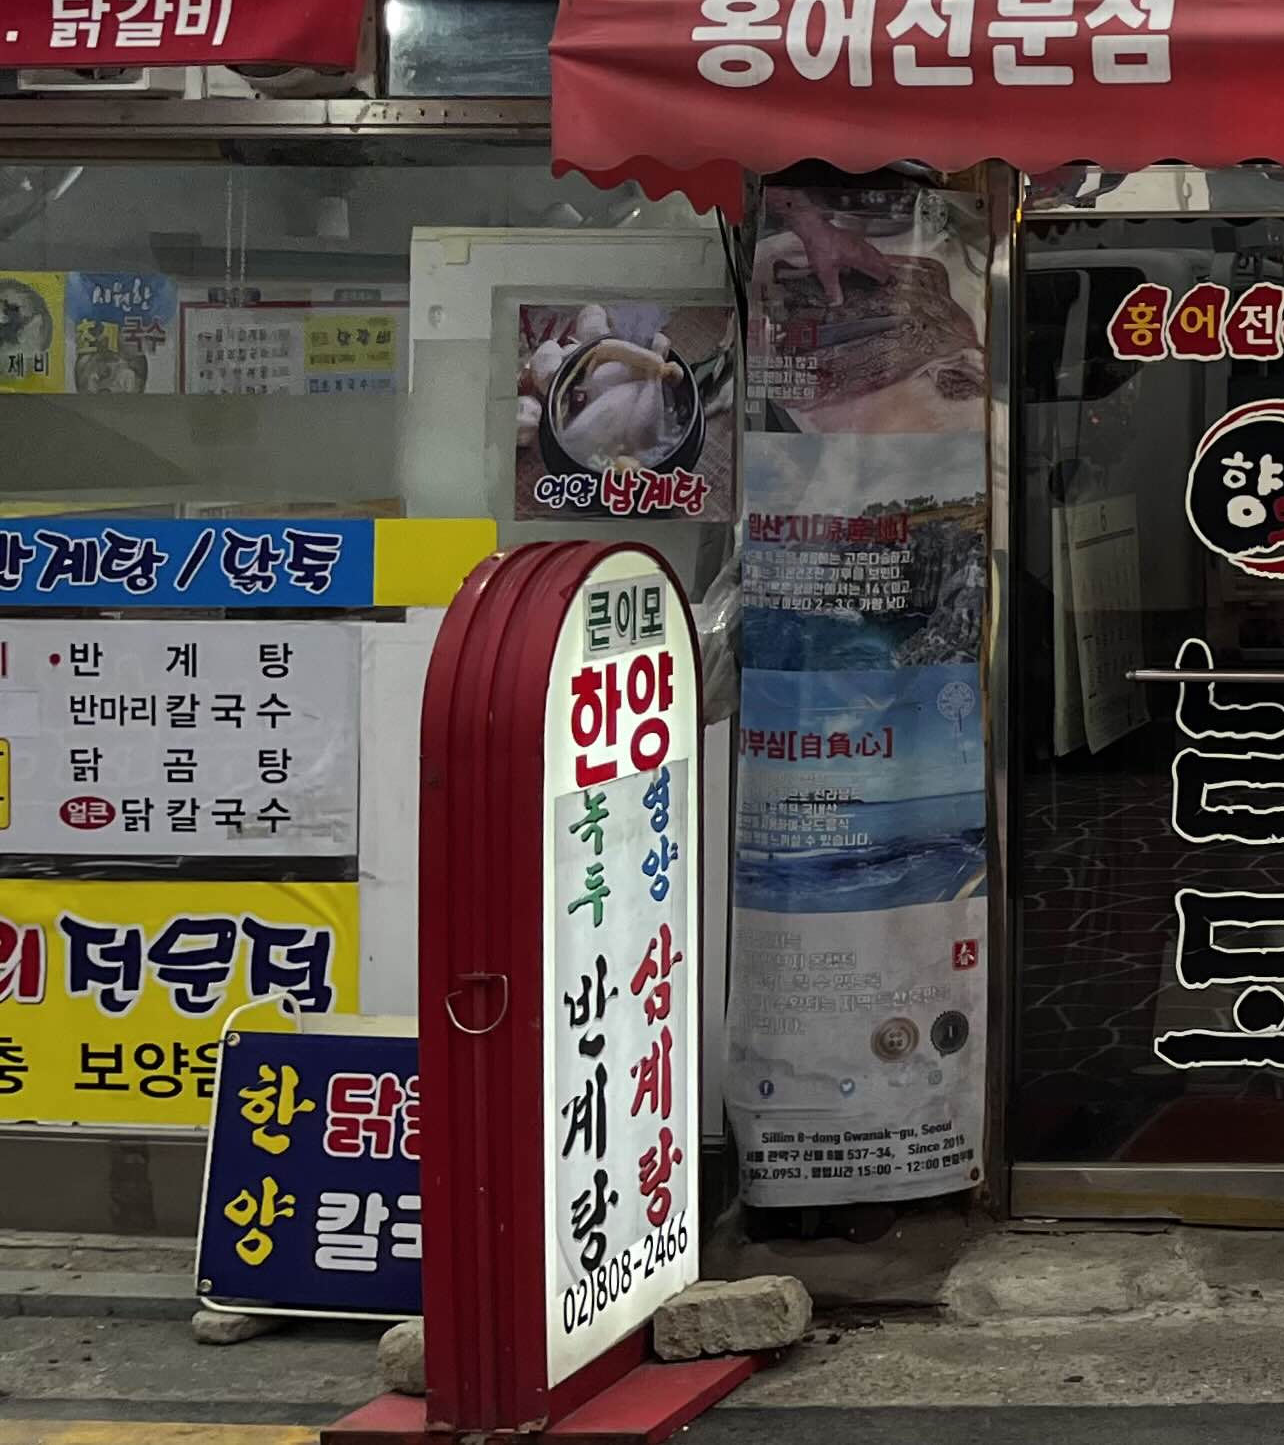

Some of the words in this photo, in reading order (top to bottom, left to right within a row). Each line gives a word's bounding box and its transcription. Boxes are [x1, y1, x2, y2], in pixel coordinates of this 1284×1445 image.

[535, 473, 597, 507] 영양
[601, 466, 710, 515] 삼계탕
[587, 585, 665, 650] 큰이모
[70, 694, 156, 727] 반마리
[166, 693, 292, 729] 칼국수
[571, 651, 673, 789] 한양
[66, 801, 109, 825] 얼큰
[224, 1063, 316, 1267] 한양
[562, 1209, 689, 1335] 02)808-2466
